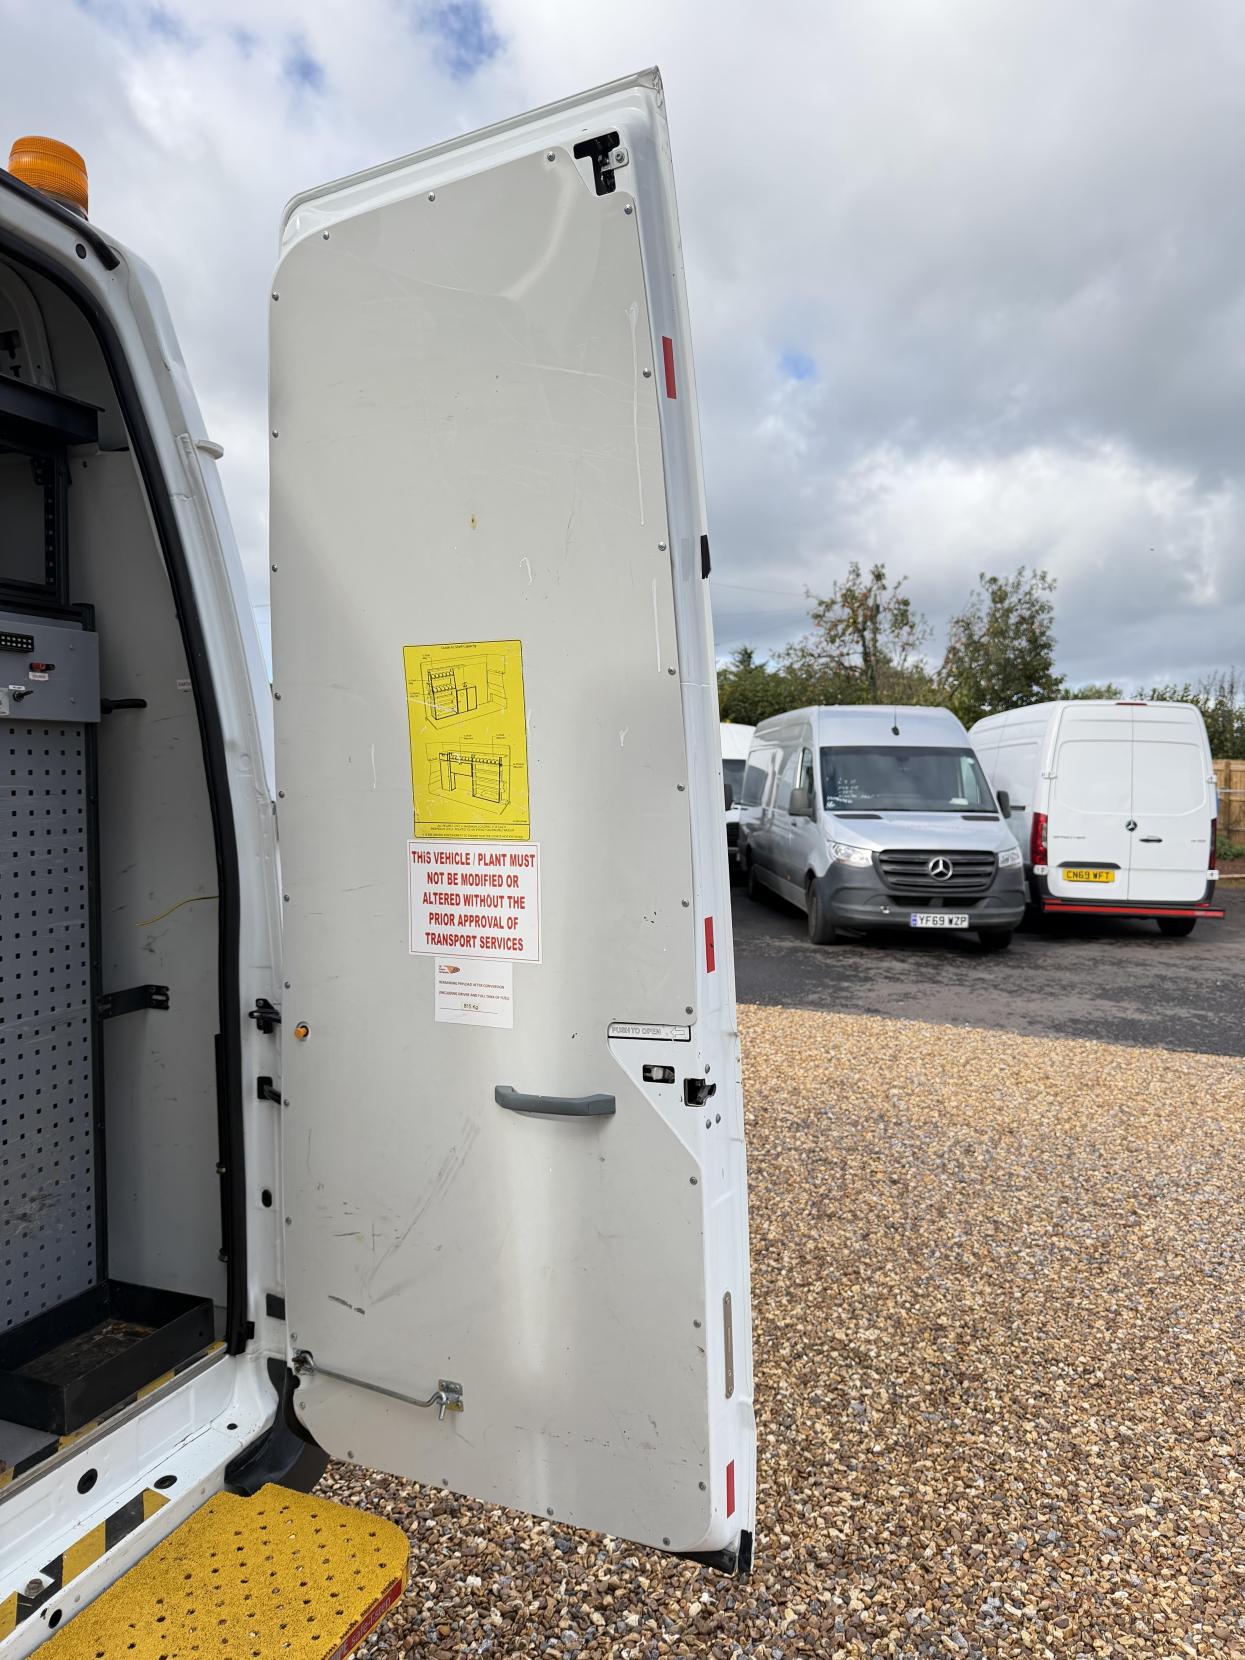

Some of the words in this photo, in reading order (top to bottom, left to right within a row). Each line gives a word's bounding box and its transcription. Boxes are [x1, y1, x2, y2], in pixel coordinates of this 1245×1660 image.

[434, 852, 470, 866] VEHICLE
[478, 853, 507, 866] PLANT
[510, 854, 536, 868] MUST
[427, 872, 444, 885] NOT
[447, 872, 458, 886] BE
[461, 873, 503, 887] MODIFIED
[506, 875, 519, 888] OR
[1066, 870, 1090, 879] CN69
[423, 892, 460, 906] ALTERED
[463, 894, 504, 908] WITHOUT
[507, 896, 526, 909] THE
[429, 912, 455, 926] PRIOR
[458, 914, 504, 929] APPROVAL
[507, 917, 518, 930] OF
[919, 915, 945, 926] YF69
[425, 932, 477, 948] TRANSPORT
[480, 936, 523, 951] SERVICES
